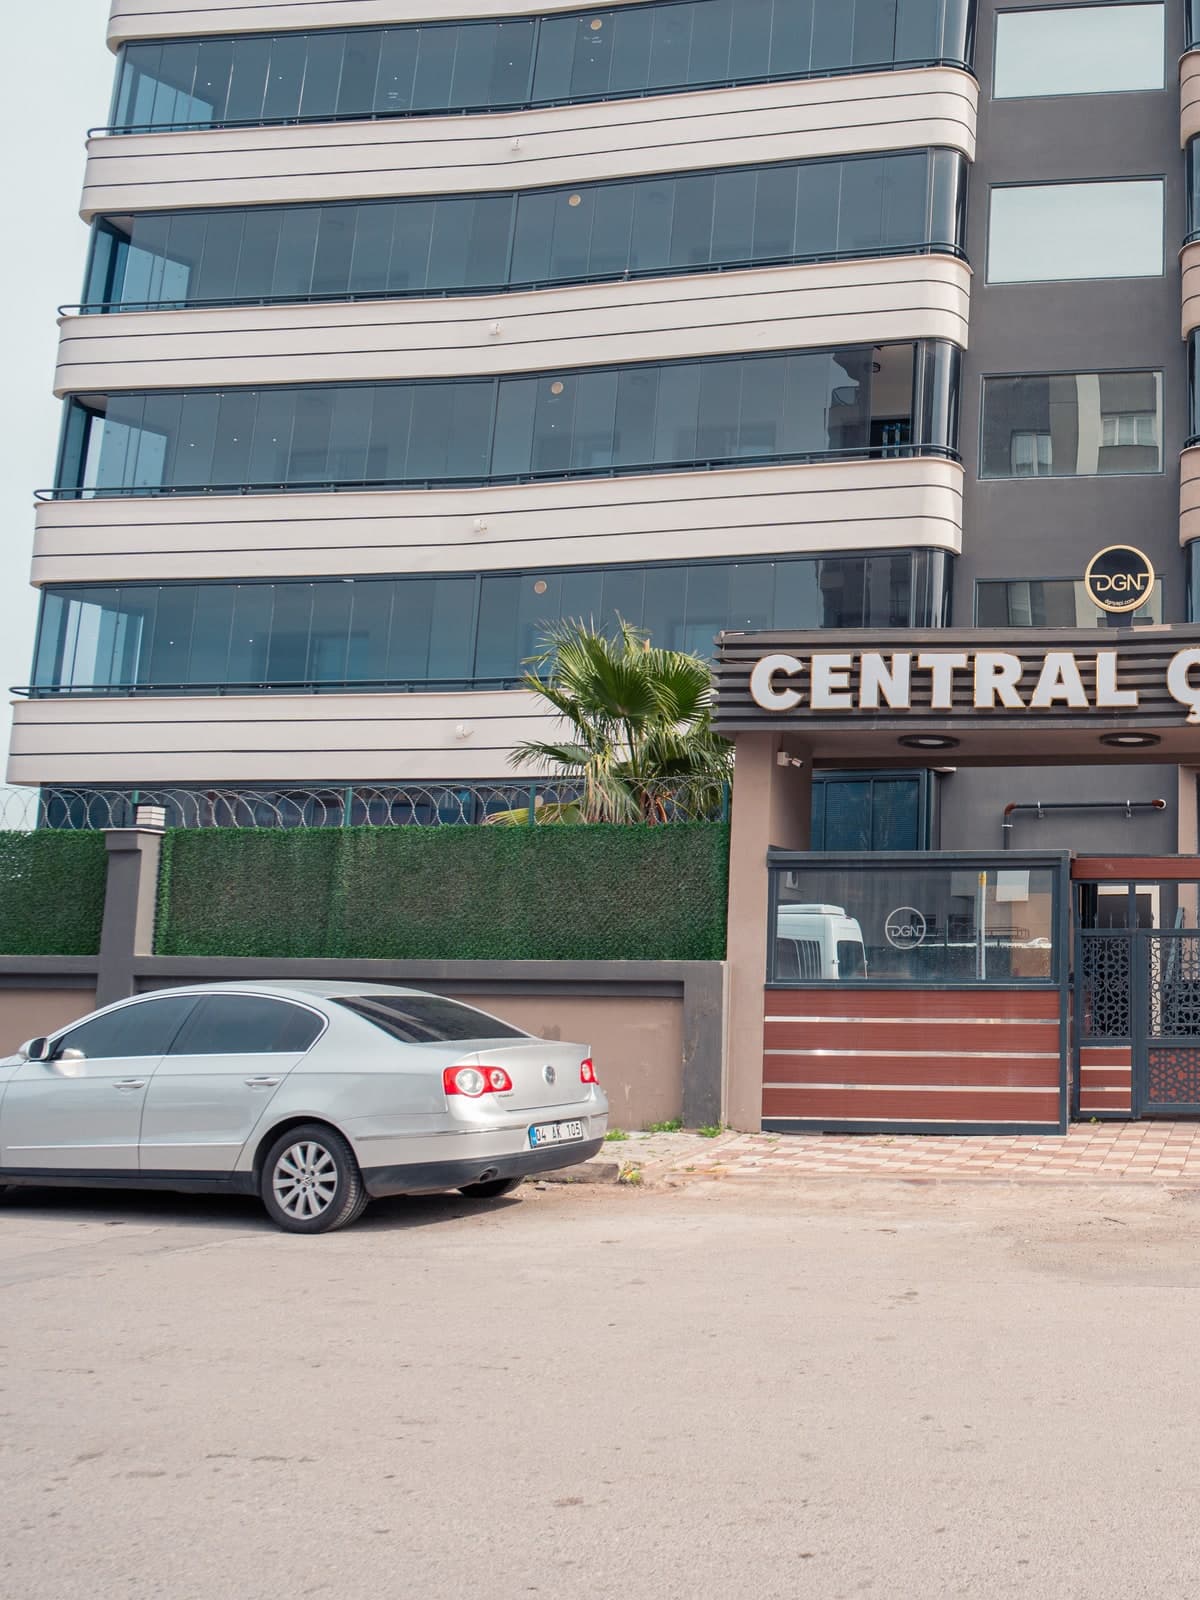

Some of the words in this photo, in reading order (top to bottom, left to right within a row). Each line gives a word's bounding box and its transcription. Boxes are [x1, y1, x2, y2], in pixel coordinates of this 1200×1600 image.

[1090, 573, 1148, 591] DGN
[749, 651, 1139, 712] CENTRAL
[888, 925, 924, 937] DGN
